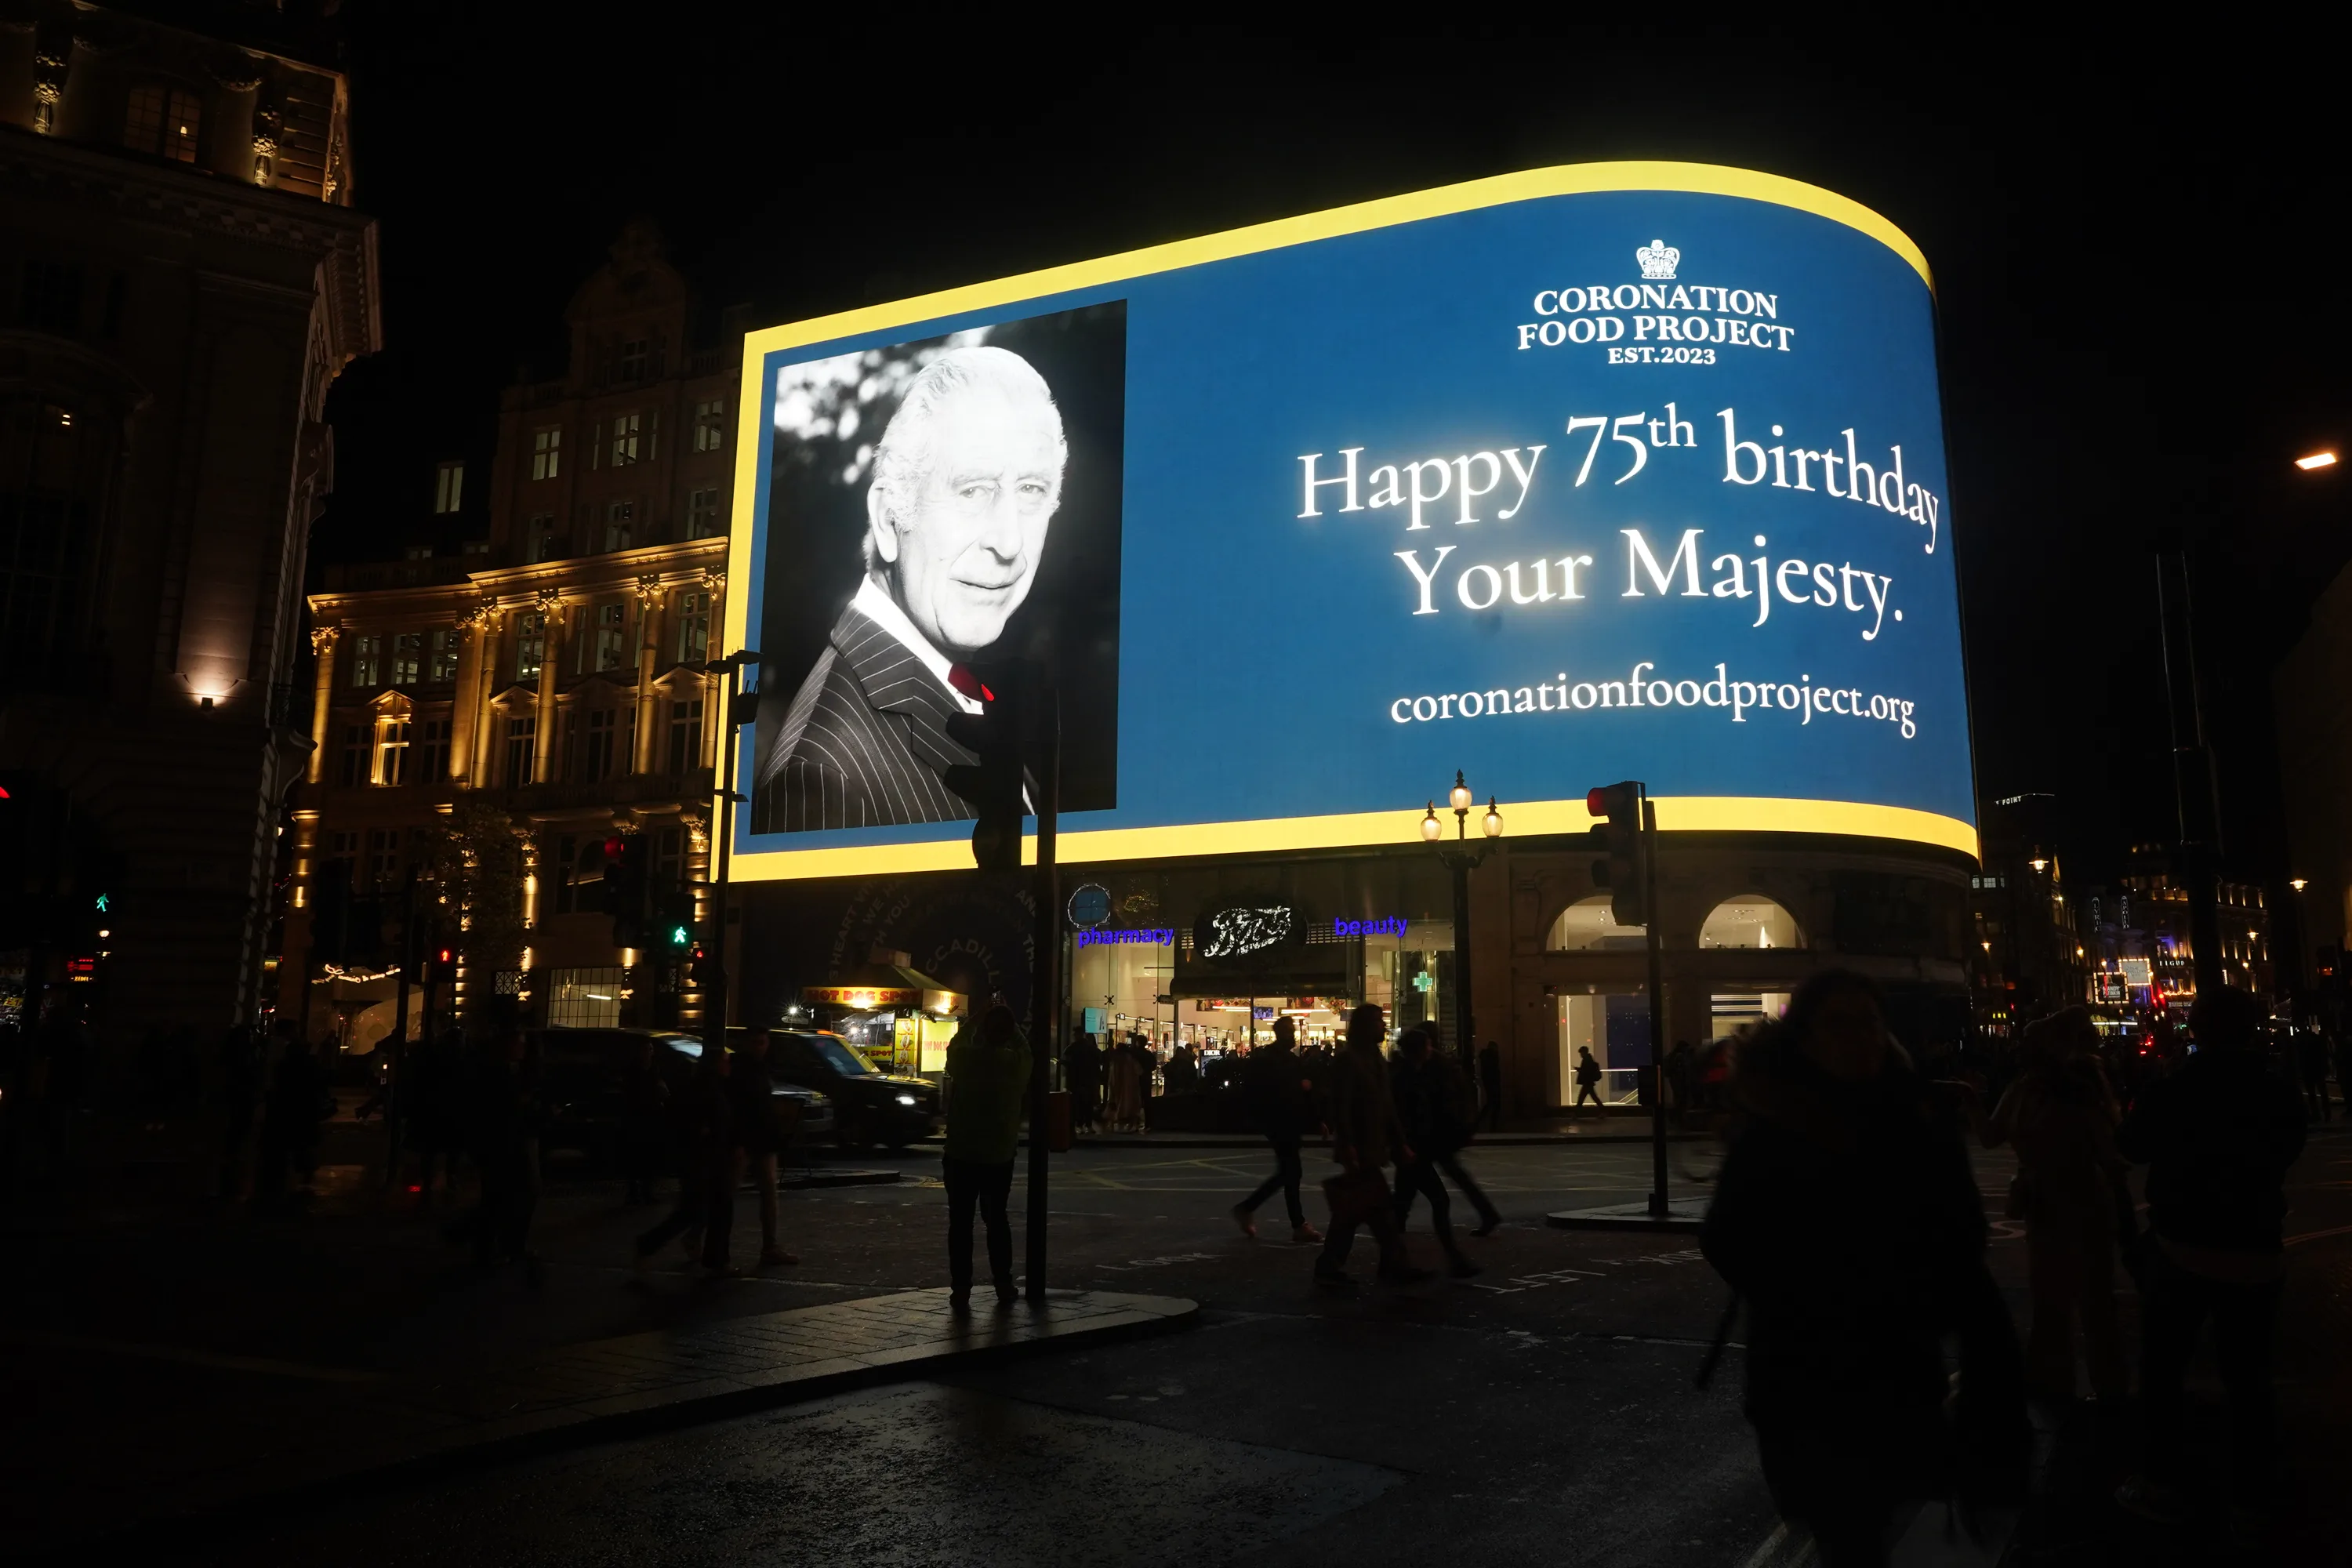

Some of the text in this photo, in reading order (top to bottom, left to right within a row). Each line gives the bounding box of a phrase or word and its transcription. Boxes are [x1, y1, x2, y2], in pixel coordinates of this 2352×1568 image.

[1534, 284, 1778, 319] CORONATION
[1517, 315, 1795, 352] FOOD PROJECT
[1607, 347, 1716, 365] EST.2023
[1297, 401, 1939, 554] Happy 75th birthday
[1393, 528, 1903, 641] Your Majesty.
[1391, 662, 1916, 739] coronationfoodproject.org
[2002, 796, 2021, 805] POINT
[1078, 927, 1174, 949] pharmacy
[1334, 915, 1407, 938] beauty
[926, 938, 1000, 985] CCADILL
[807, 990, 919, 1003] HOT DOG SPOT
